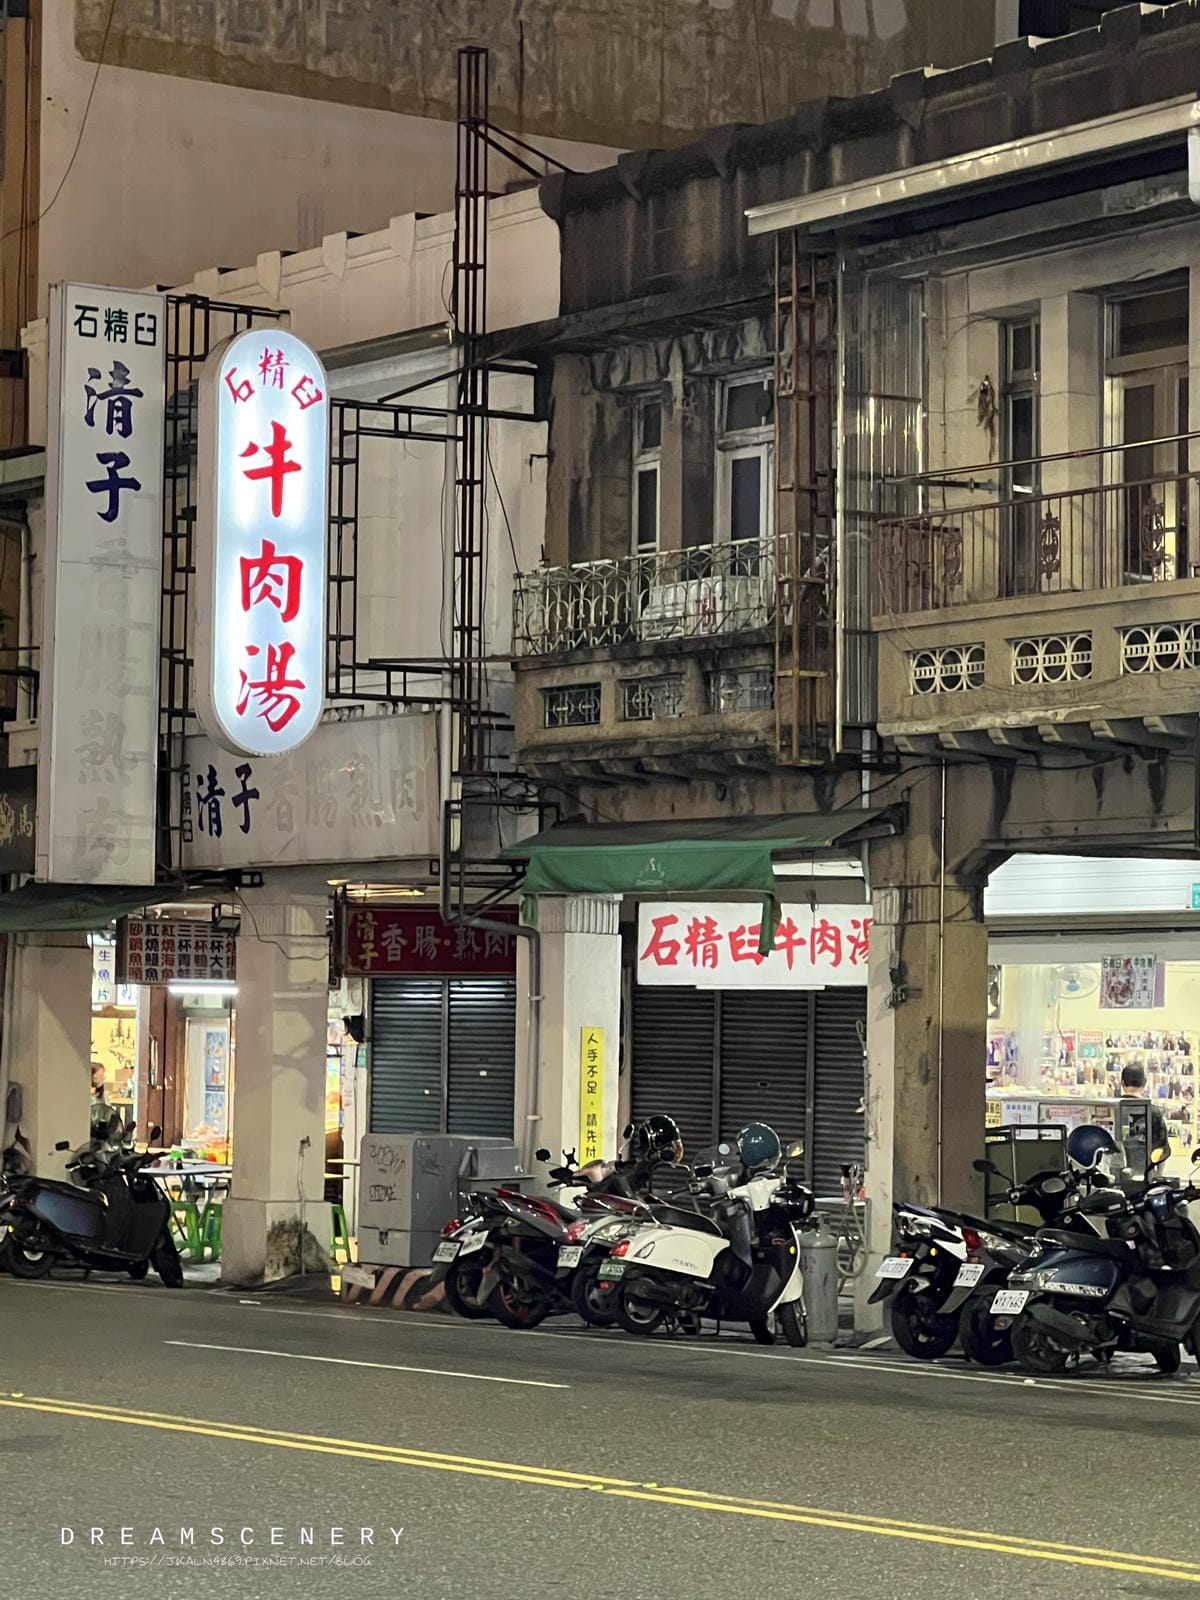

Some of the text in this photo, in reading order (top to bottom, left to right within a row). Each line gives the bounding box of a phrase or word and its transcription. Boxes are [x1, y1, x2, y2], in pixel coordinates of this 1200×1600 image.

[74, 303, 157, 347] 石精臼
[224, 347, 323, 410] 石精臼
[84, 360, 144, 522] 清子
[236, 419, 306, 733] 牛肉湯
[196, 762, 260, 839] 清子
[357, 911, 379, 970] 清子
